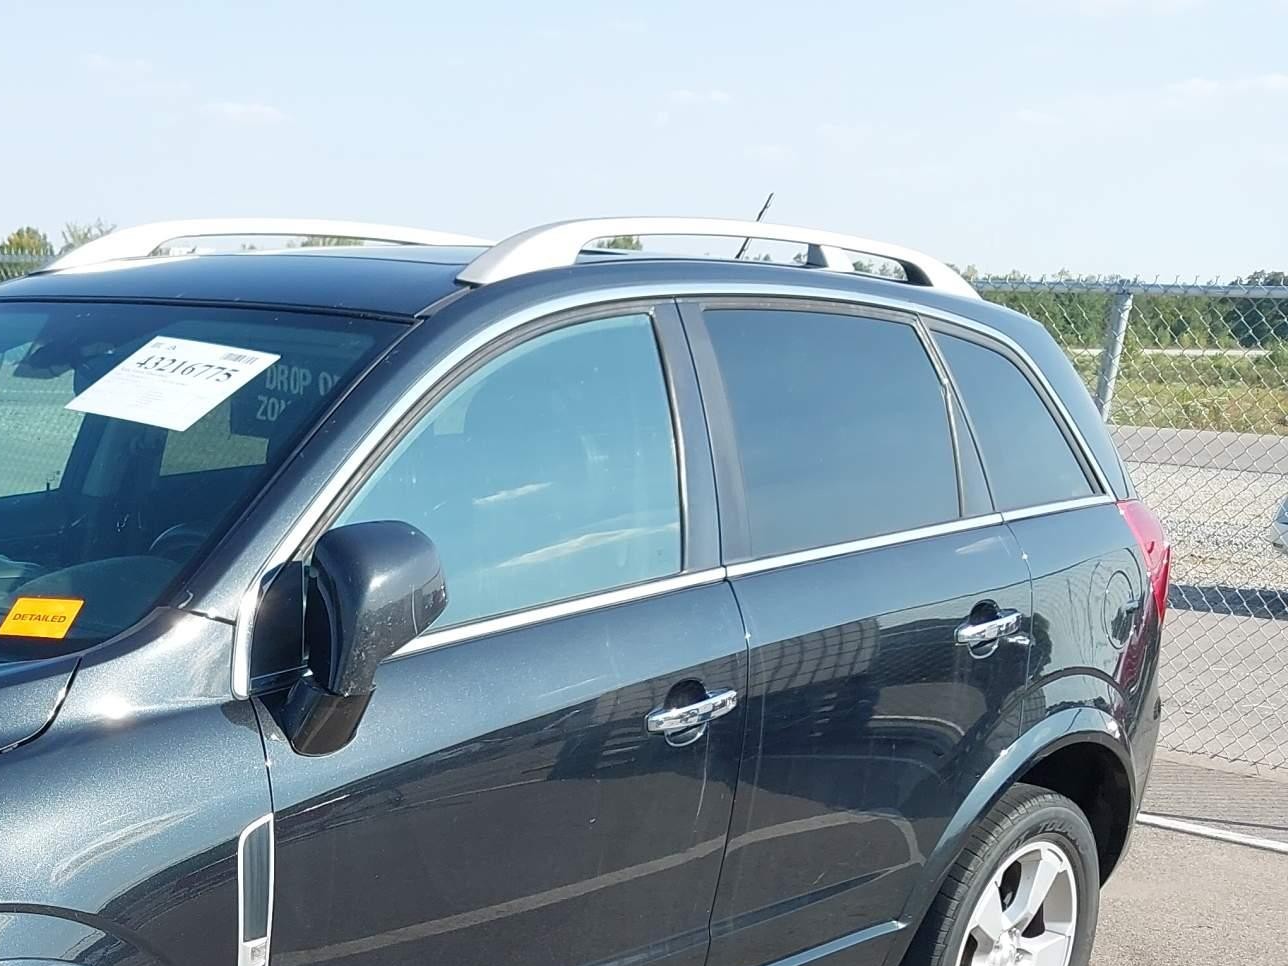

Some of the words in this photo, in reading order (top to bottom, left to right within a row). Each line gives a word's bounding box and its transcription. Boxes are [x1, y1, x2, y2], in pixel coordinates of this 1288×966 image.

[136, 354, 240, 383] 43216775
[265, 364, 312, 396] DROP
[13, 613, 67, 624] DETAILED
